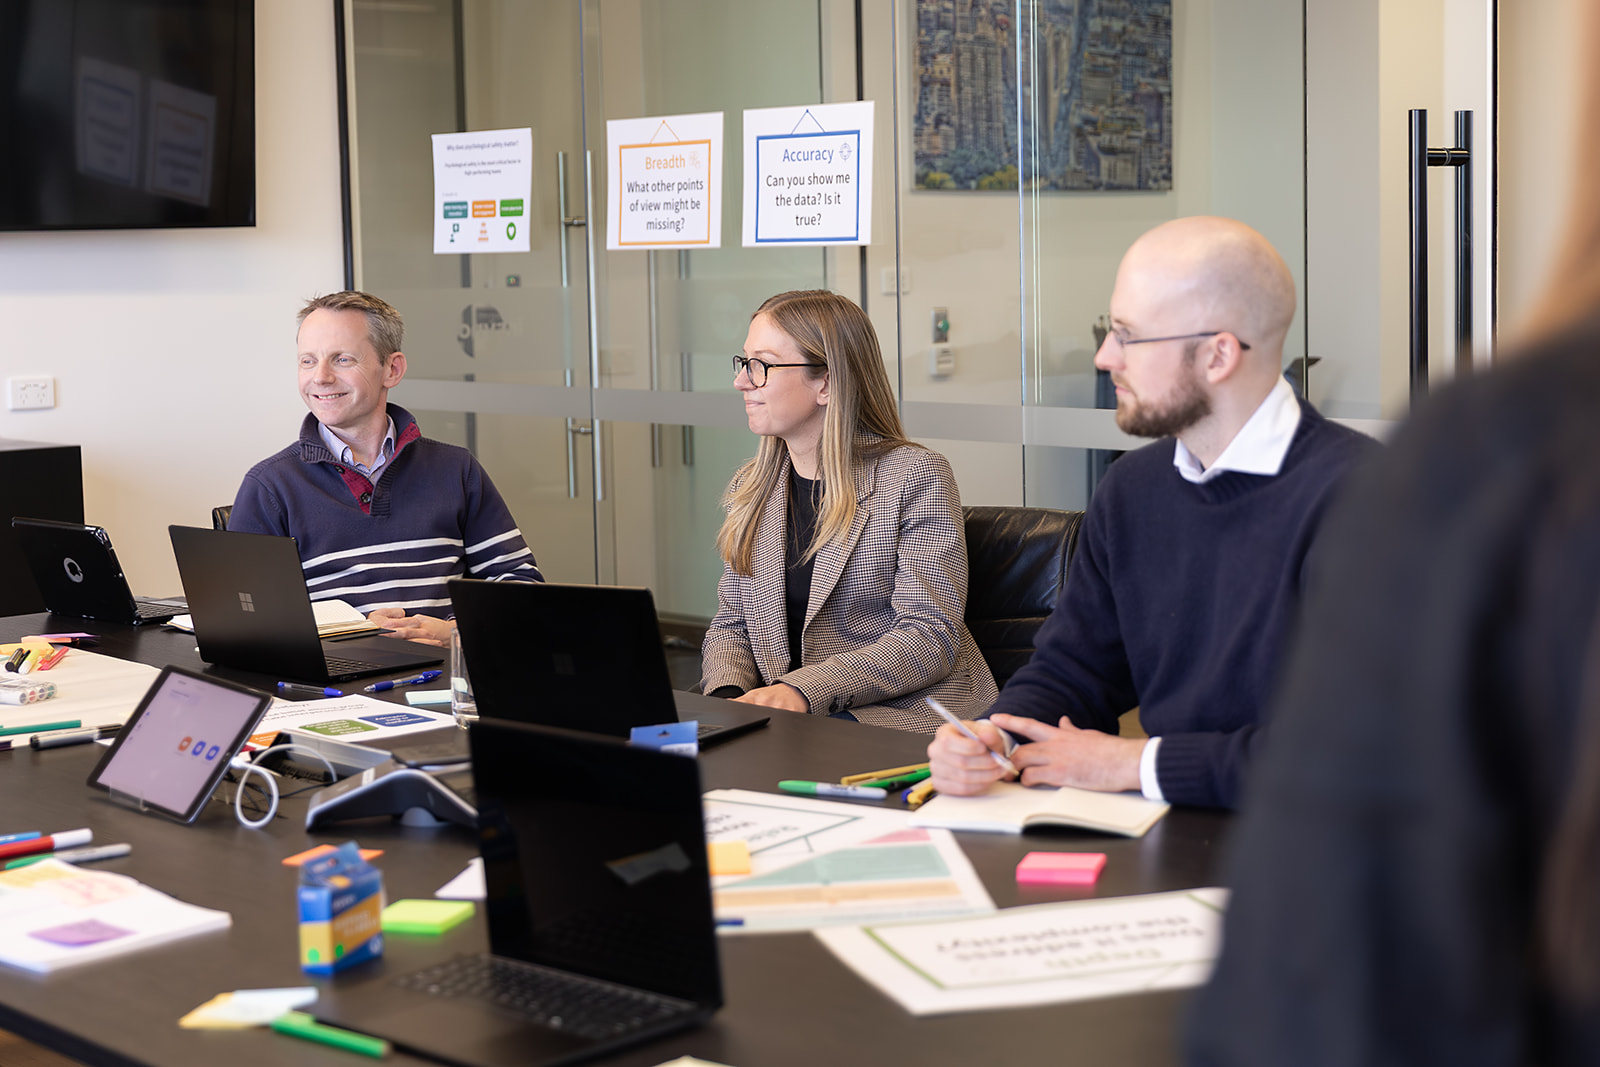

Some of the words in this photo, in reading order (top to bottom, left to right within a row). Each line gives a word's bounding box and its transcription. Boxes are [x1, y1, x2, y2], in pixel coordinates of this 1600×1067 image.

[645, 154, 686, 170] Breadth
[782, 148, 834, 164] Accuracy
[627, 181, 649, 193] What
[651, 180, 675, 192] other
[677, 178, 704, 194] points
[766, 174, 784, 187] Can
[787, 176, 805, 189] you
[807, 172, 833, 185] show
[836, 173, 850, 184] me
[629, 200, 639, 212] of
[640, 199, 661, 212] view
[663, 198, 689, 214] might
[690, 198, 701, 210] be
[776, 194, 792, 206] the
[794, 192, 822, 206] data?
[824, 193, 832, 205] Is
[834, 192, 841, 204] it
[646, 217, 686, 233] missing?
[795, 212, 822, 226] true?
